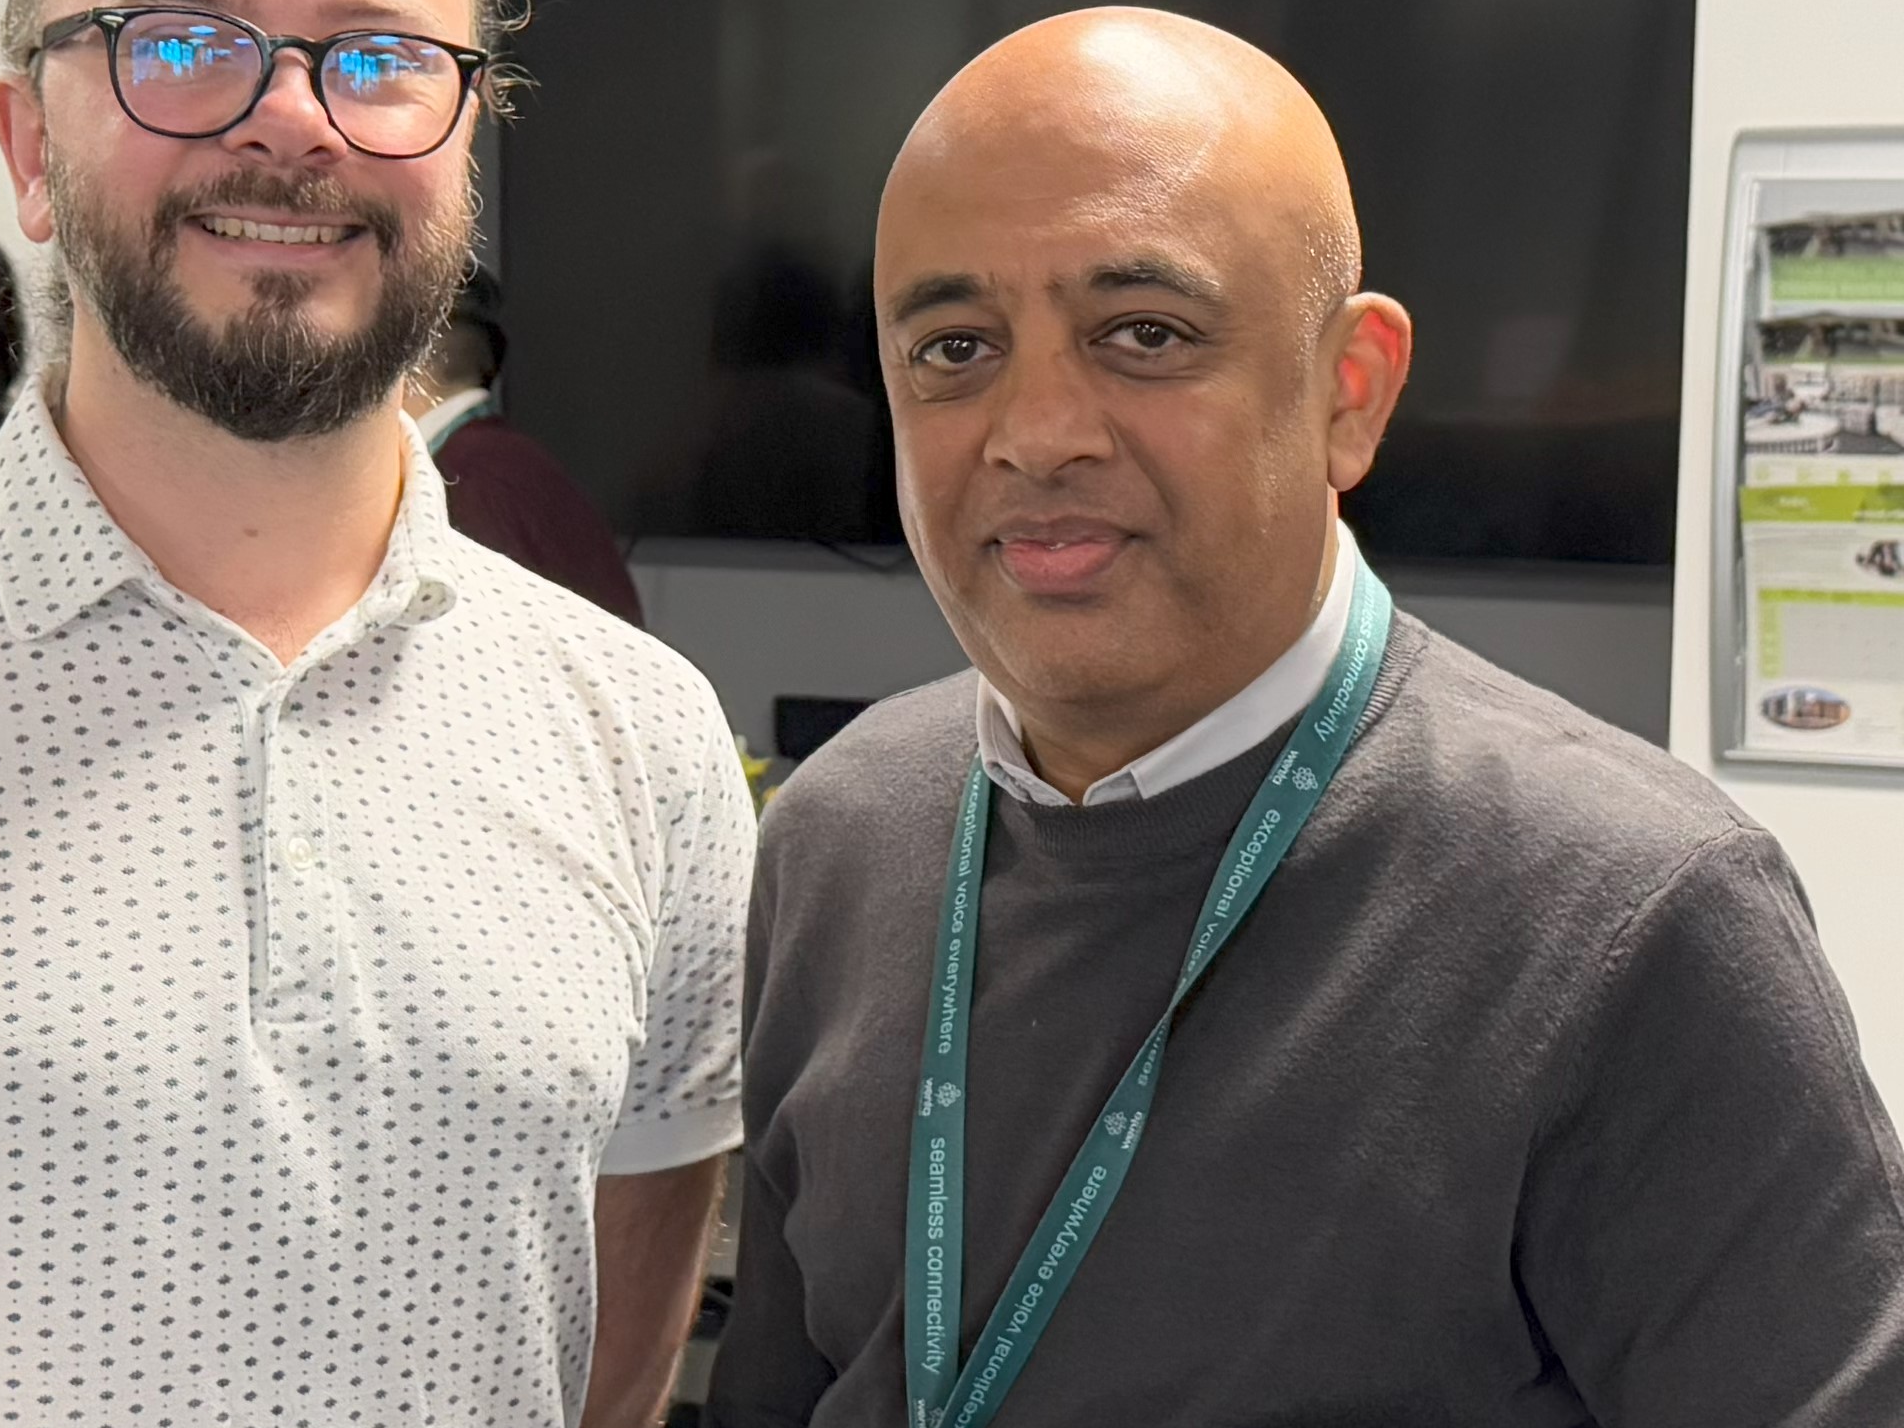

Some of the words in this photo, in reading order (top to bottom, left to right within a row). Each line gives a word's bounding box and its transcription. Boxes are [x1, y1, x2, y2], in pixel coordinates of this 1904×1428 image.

[1313, 639, 1369, 742] connectivity
[958, 771, 982, 877] exceptional
[1214, 809, 1281, 918] exceptional
[951, 881, 969, 934] voice
[1187, 922, 1218, 972] voice
[937, 938, 961, 1054] everywhere
[927, 1136, 949, 1240] seamless
[1006, 1283, 1043, 1334] voice
[1038, 1165, 1107, 1280] everywhere
[921, 1246, 946, 1376] connectivity
